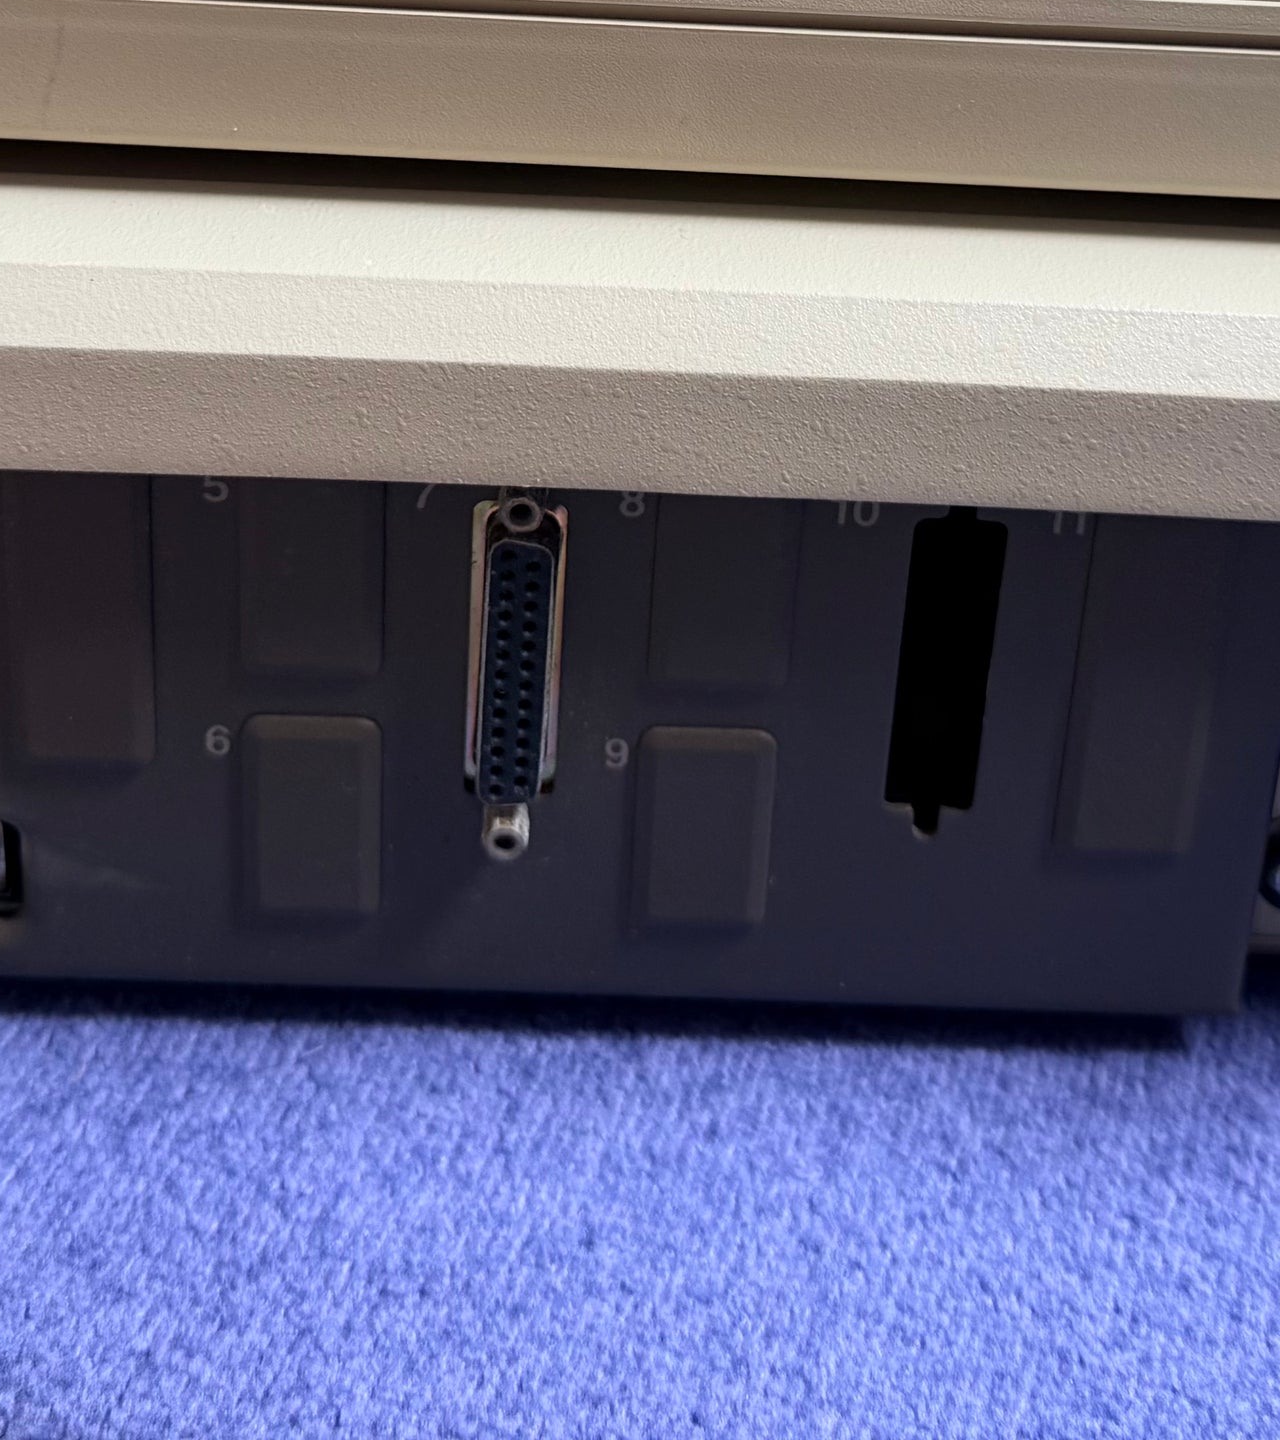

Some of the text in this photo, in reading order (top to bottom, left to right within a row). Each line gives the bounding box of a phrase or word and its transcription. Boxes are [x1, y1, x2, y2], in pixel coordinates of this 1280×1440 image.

[203, 475, 230, 503] 5
[619, 490, 646, 518] 8
[836, 499, 881, 528] 10
[205, 724, 231, 757] 6
[605, 737, 630, 768] 9
